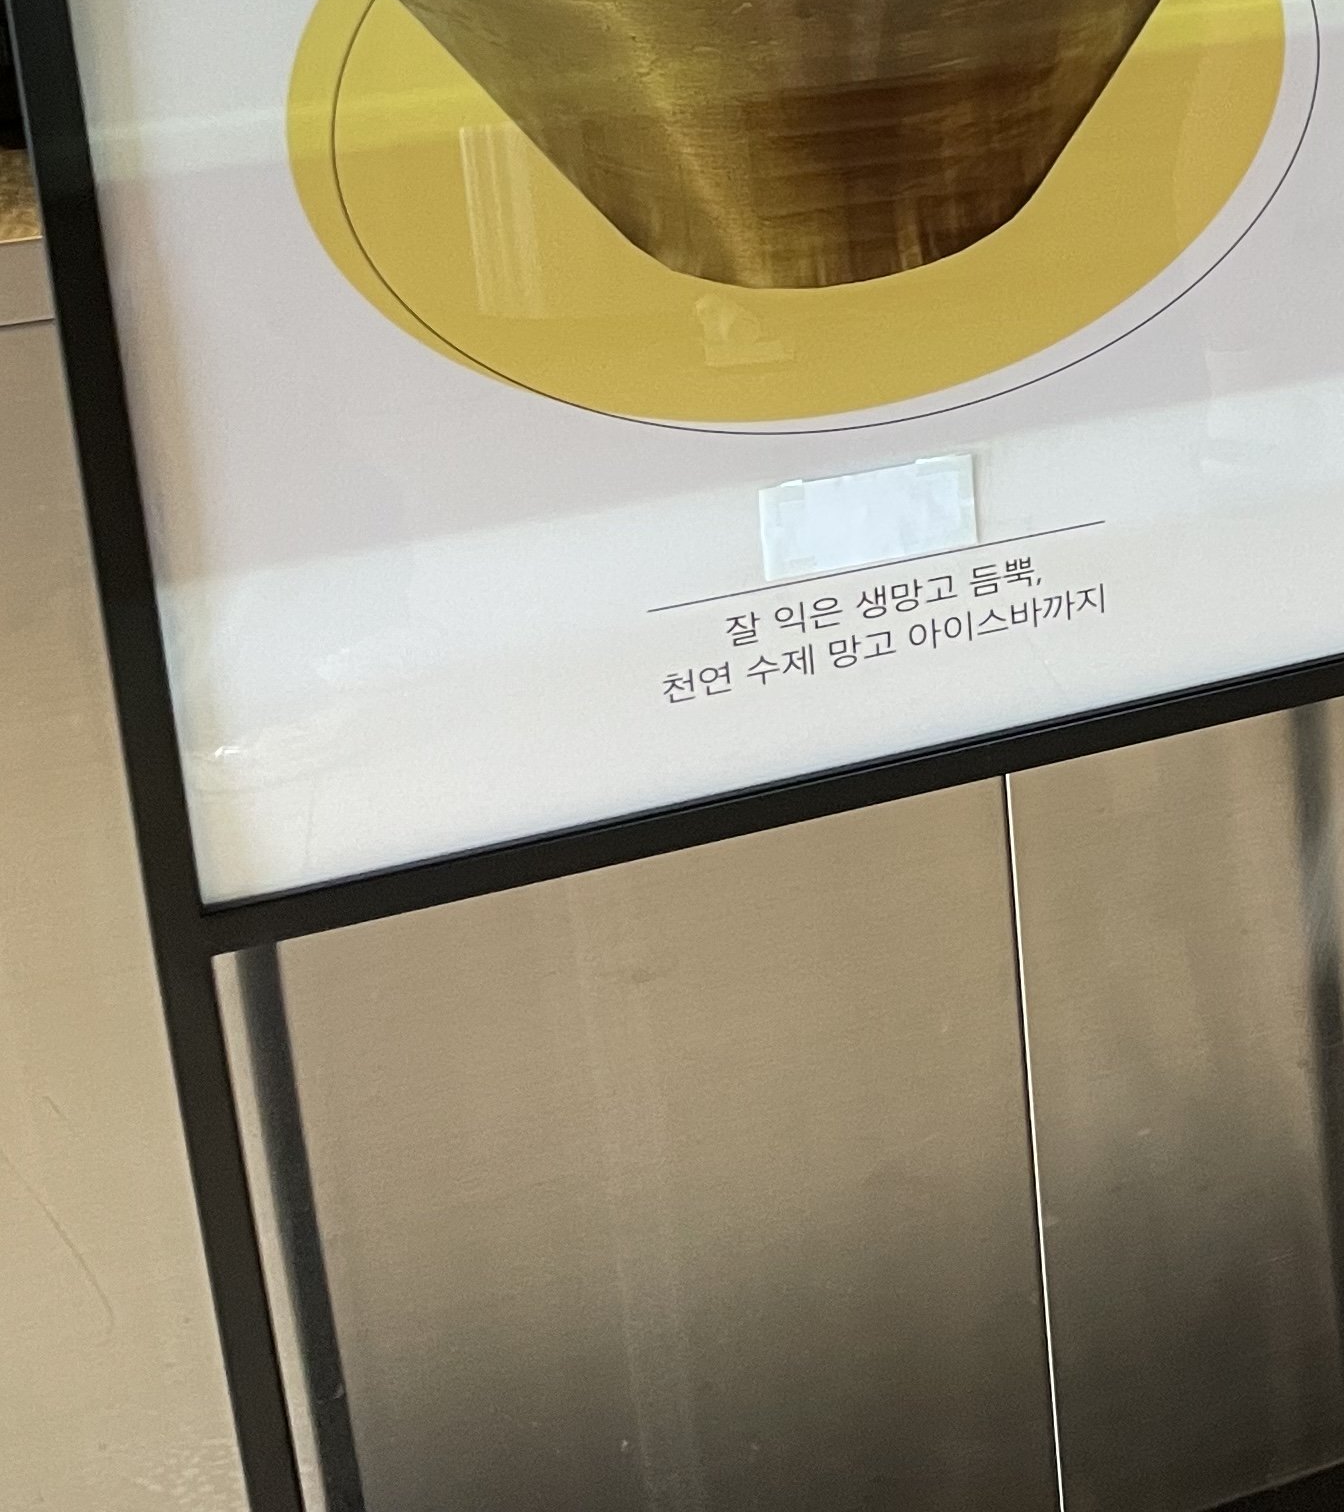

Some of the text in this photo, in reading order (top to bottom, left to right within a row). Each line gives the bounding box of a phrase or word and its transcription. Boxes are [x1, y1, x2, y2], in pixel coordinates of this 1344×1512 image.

[662, 583, 1106, 704] 천연 수제 망고 아이스바까지
[725, 557, 1043, 646] 잘 익은 생망고 듬뿍,
